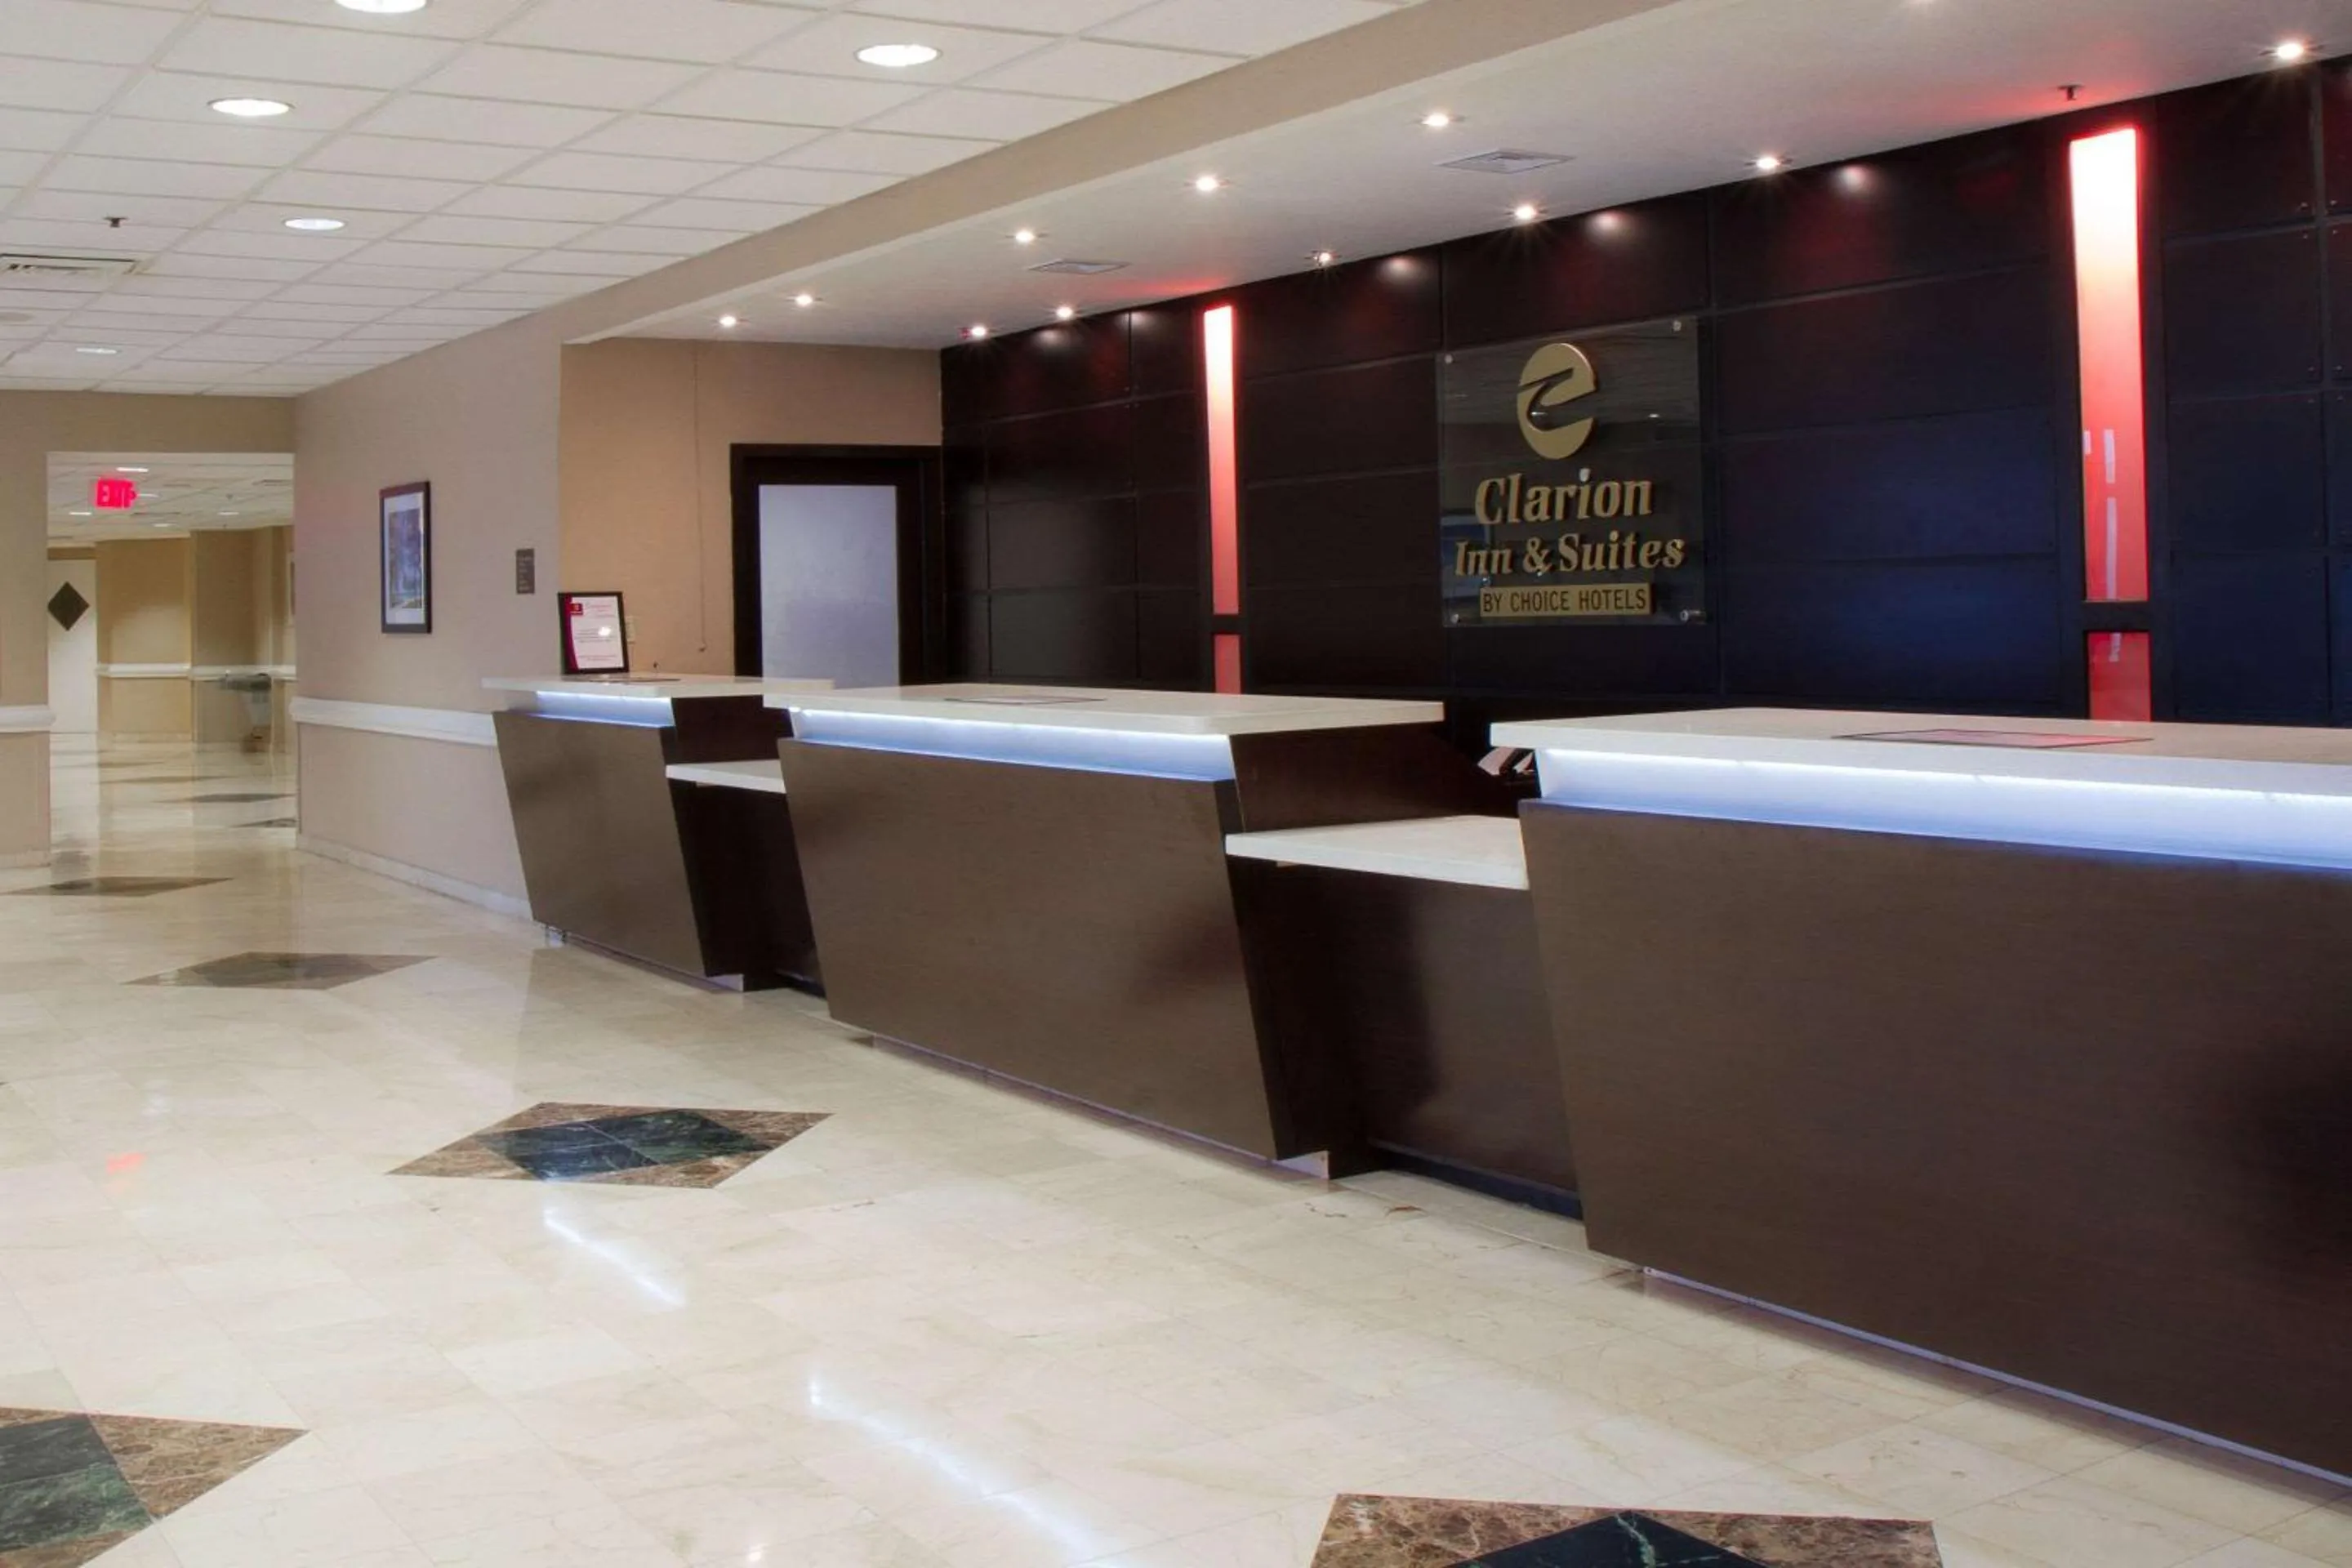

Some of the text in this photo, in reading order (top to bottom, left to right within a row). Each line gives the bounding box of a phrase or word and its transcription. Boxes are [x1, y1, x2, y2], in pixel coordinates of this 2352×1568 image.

[96, 479, 133, 508] EXIT
[1474, 467, 1653, 525] Clarion
[1454, 529, 1686, 576] Inn & Suites
[1482, 588, 1647, 612] BY CHOICE HOTELS
